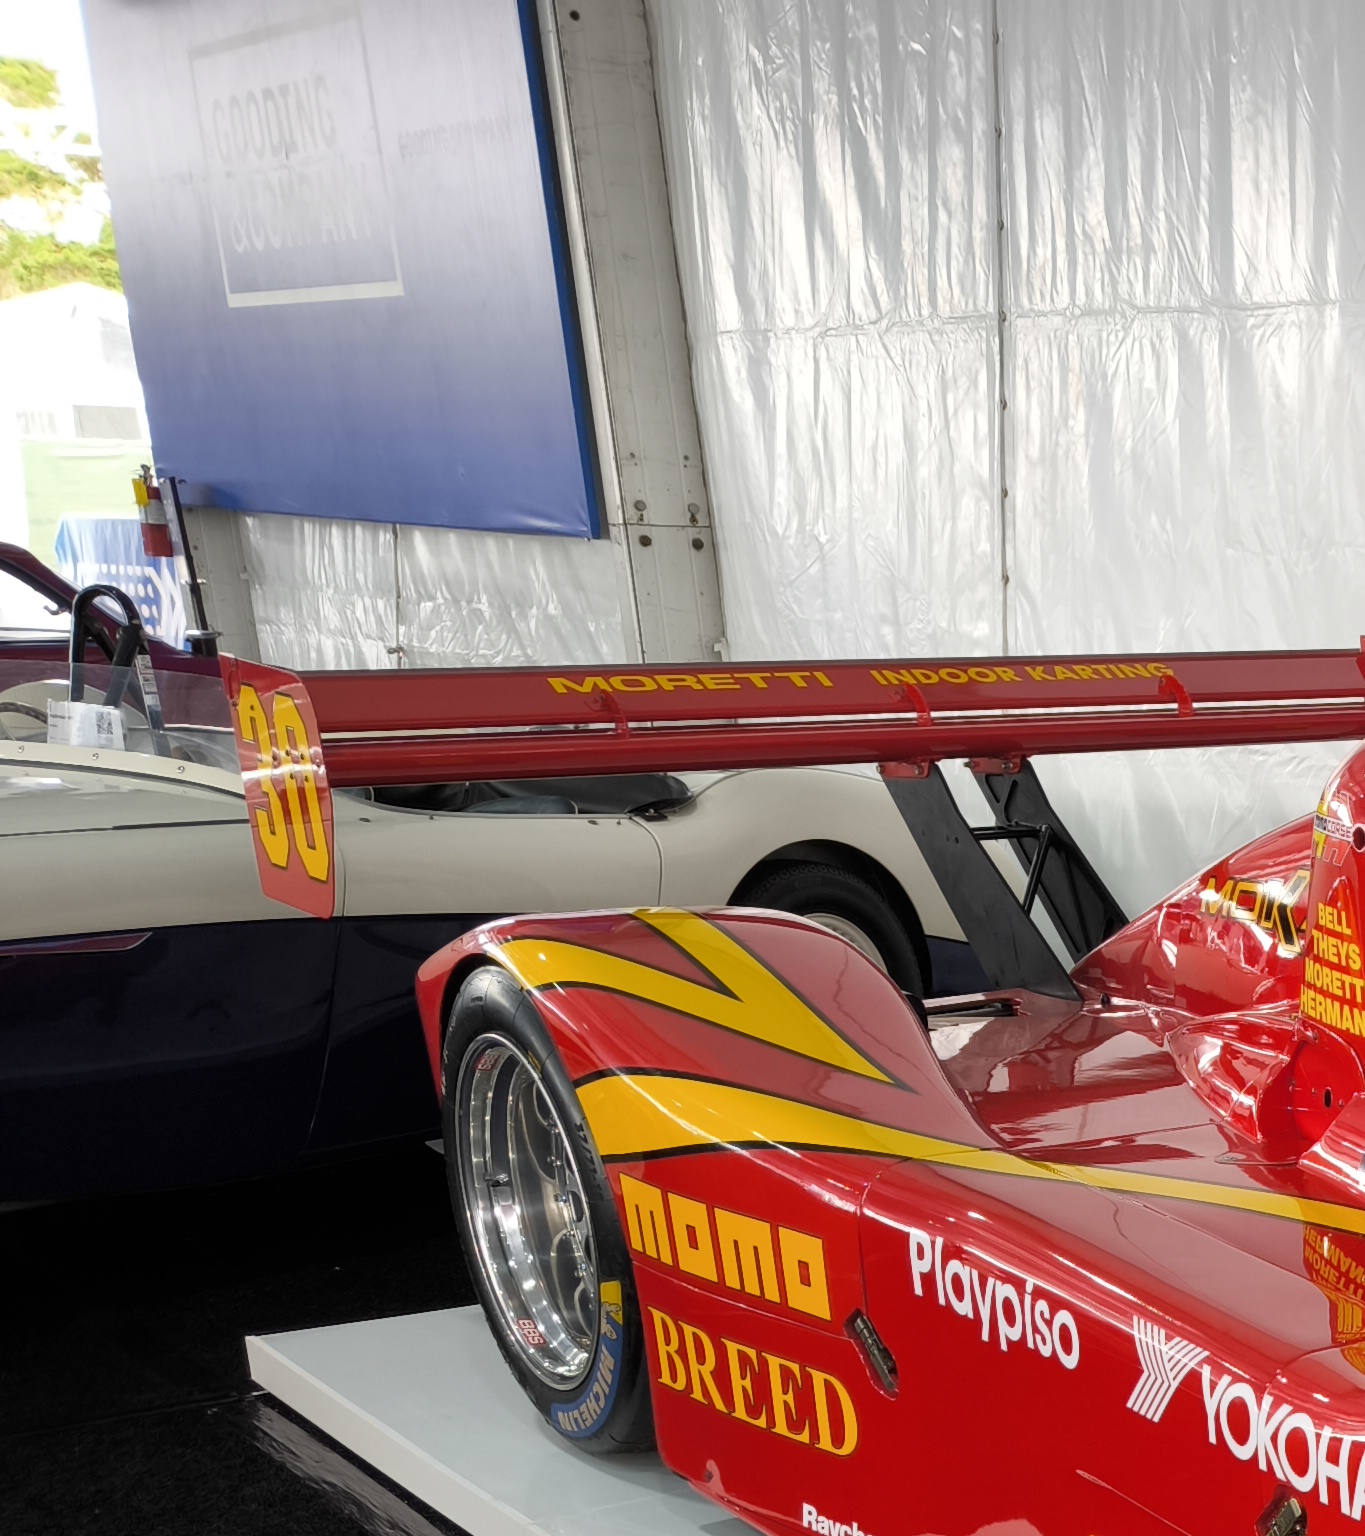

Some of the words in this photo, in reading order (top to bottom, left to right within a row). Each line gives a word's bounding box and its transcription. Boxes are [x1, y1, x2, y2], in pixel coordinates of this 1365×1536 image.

[212, 73, 336, 168] GOODING
[547, 671, 833, 694] MORETTI
[870, 666, 1015, 687] INDOOR
[1025, 662, 1175, 681] KARTING
[238, 682, 331, 882] 30
[1311, 928, 1361, 971] THEYS
[1317, 902, 1352, 936] BELL
[517, 1317, 545, 1348] BBS
[908, 1227, 1080, 1370] Playpiso
[557, 1344, 616, 1431] MICHELIN
[646, 1305, 859, 1457] BREED
